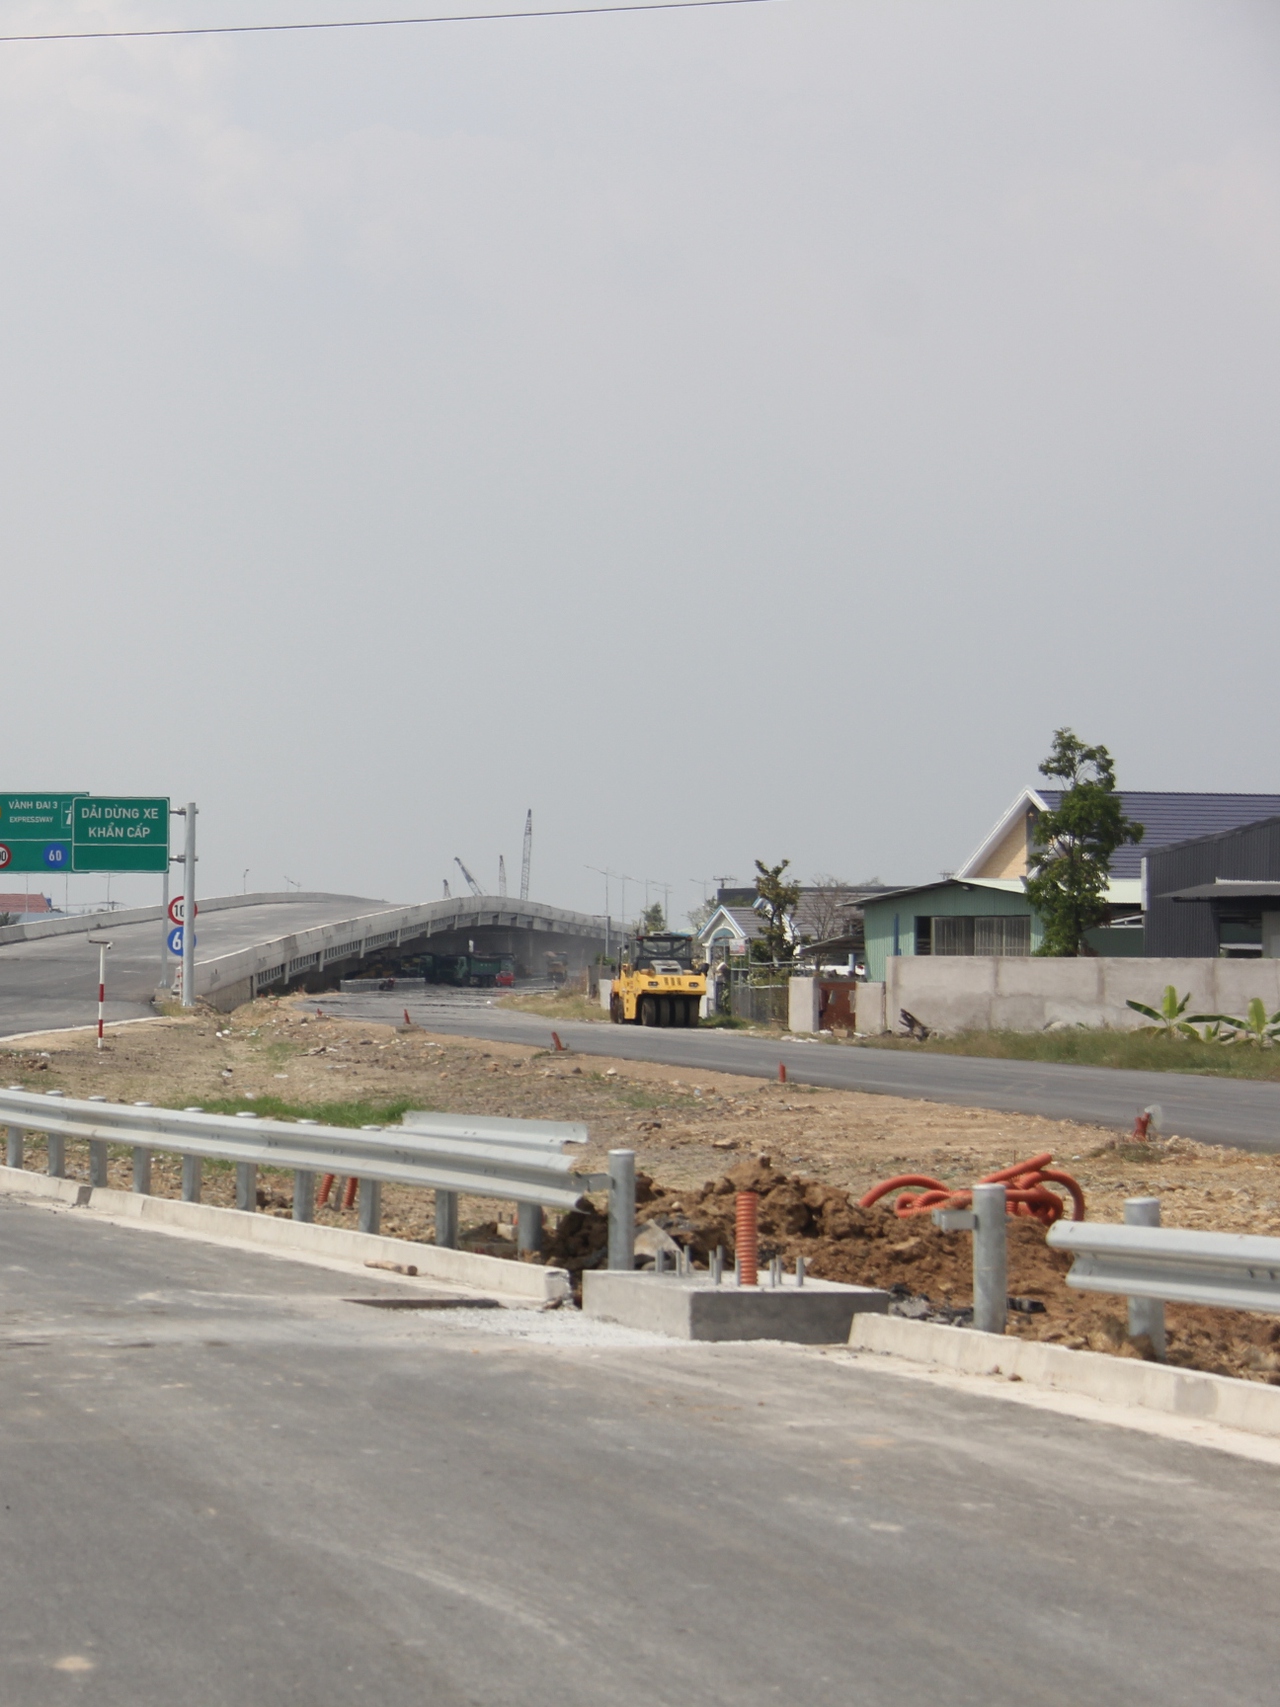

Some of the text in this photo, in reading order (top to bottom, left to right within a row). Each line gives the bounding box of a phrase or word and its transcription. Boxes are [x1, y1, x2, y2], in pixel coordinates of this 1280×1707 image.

[8, 799, 33, 810] VÀNH
[52, 801, 58, 809] 3
[143, 808, 159, 819] XE
[48, 850, 62, 862] 60
